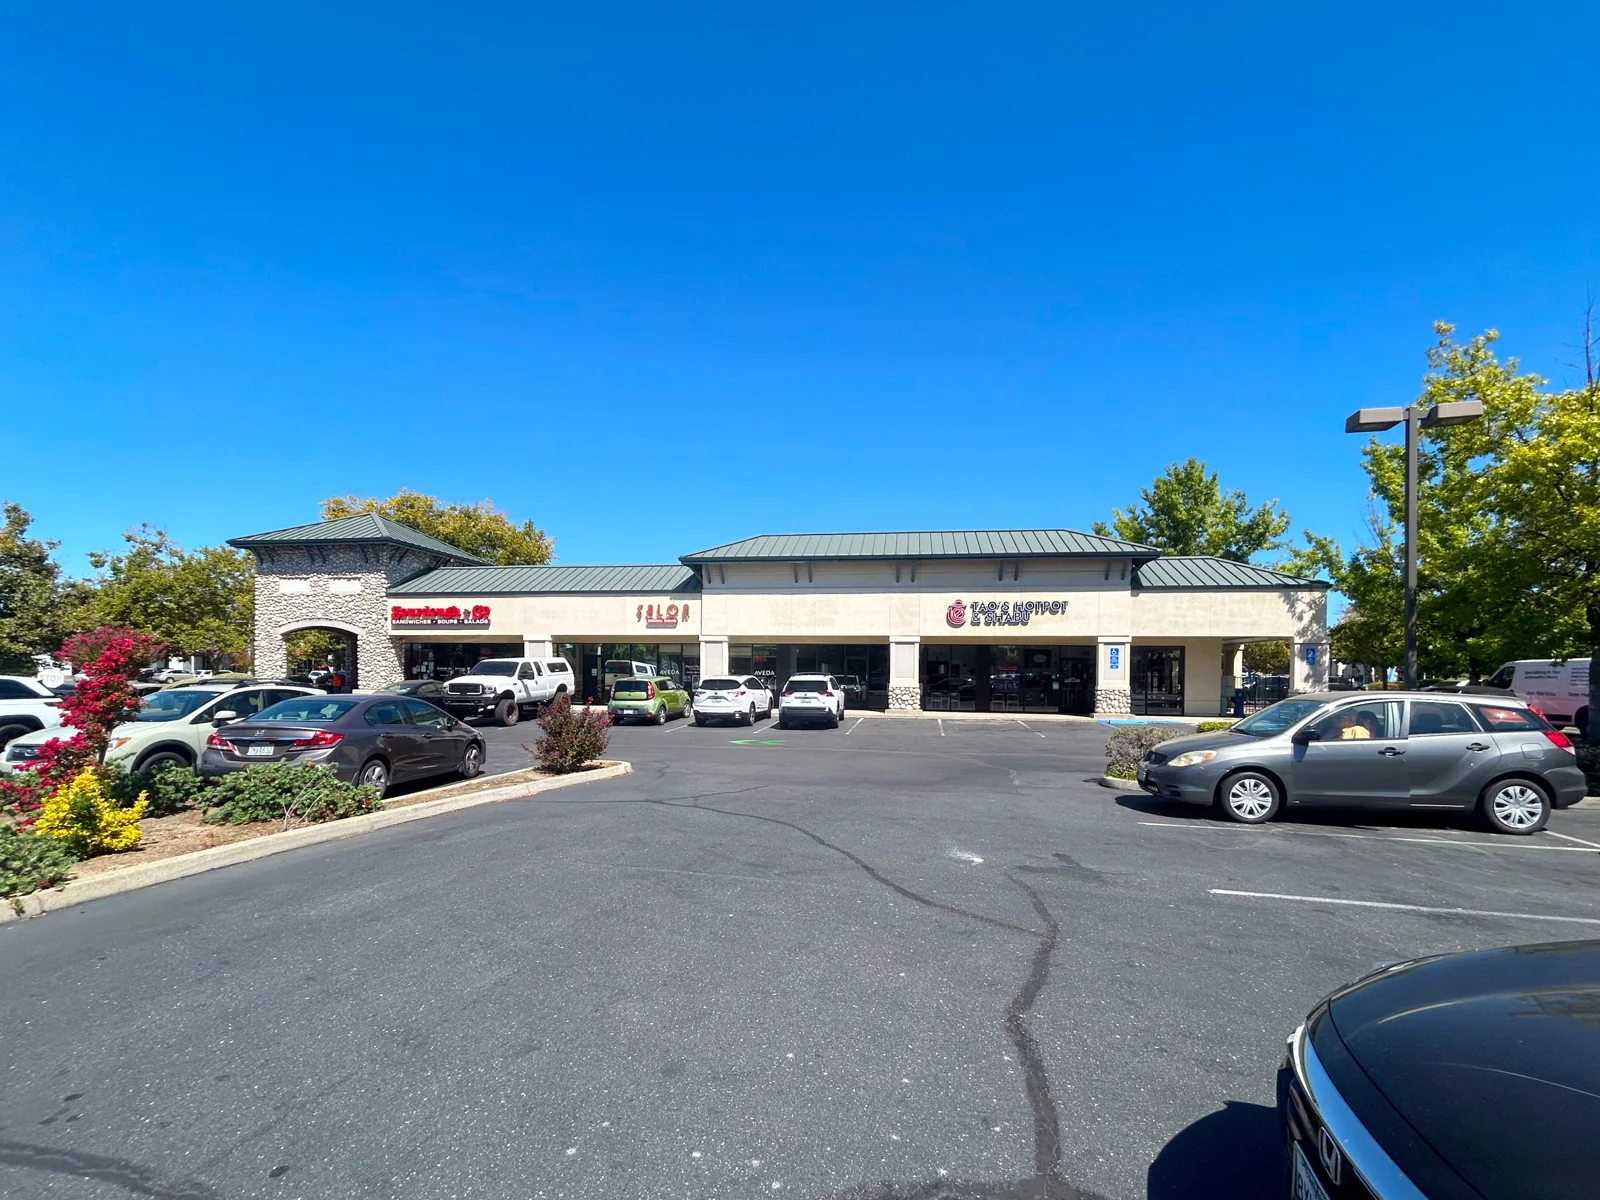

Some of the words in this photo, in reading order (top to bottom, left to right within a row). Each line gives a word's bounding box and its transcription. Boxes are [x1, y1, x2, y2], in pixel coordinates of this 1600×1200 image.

[971, 601, 1009, 612] TAO'S
[1015, 601, 1068, 612] HOTPOT
[972, 612, 981, 623] &
[986, 612, 1031, 623] SHABU
[40, 674, 62, 682] STOP
